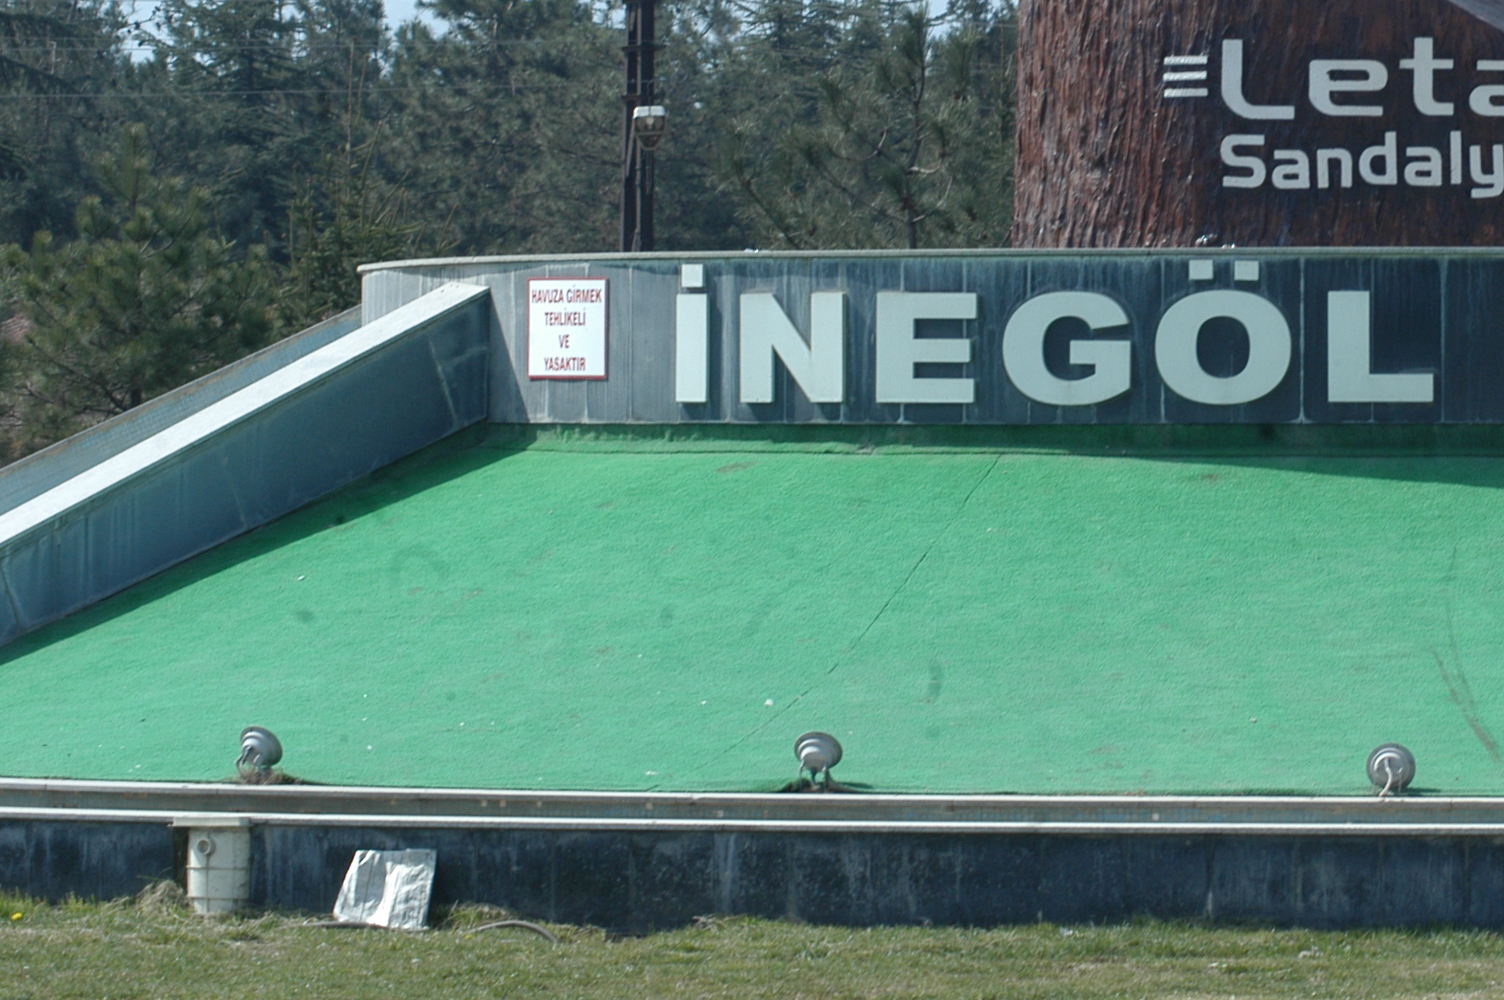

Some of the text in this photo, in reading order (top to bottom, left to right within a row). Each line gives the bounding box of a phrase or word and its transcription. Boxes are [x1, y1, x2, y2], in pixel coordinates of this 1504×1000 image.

[531, 288, 564, 303] HAVUZA
[544, 307, 586, 326] TEHLİKELİ
[675, 259, 1434, 405] İNEGÖL
[558, 334, 570, 349] VE
[544, 357, 585, 371] YASAKTIR
